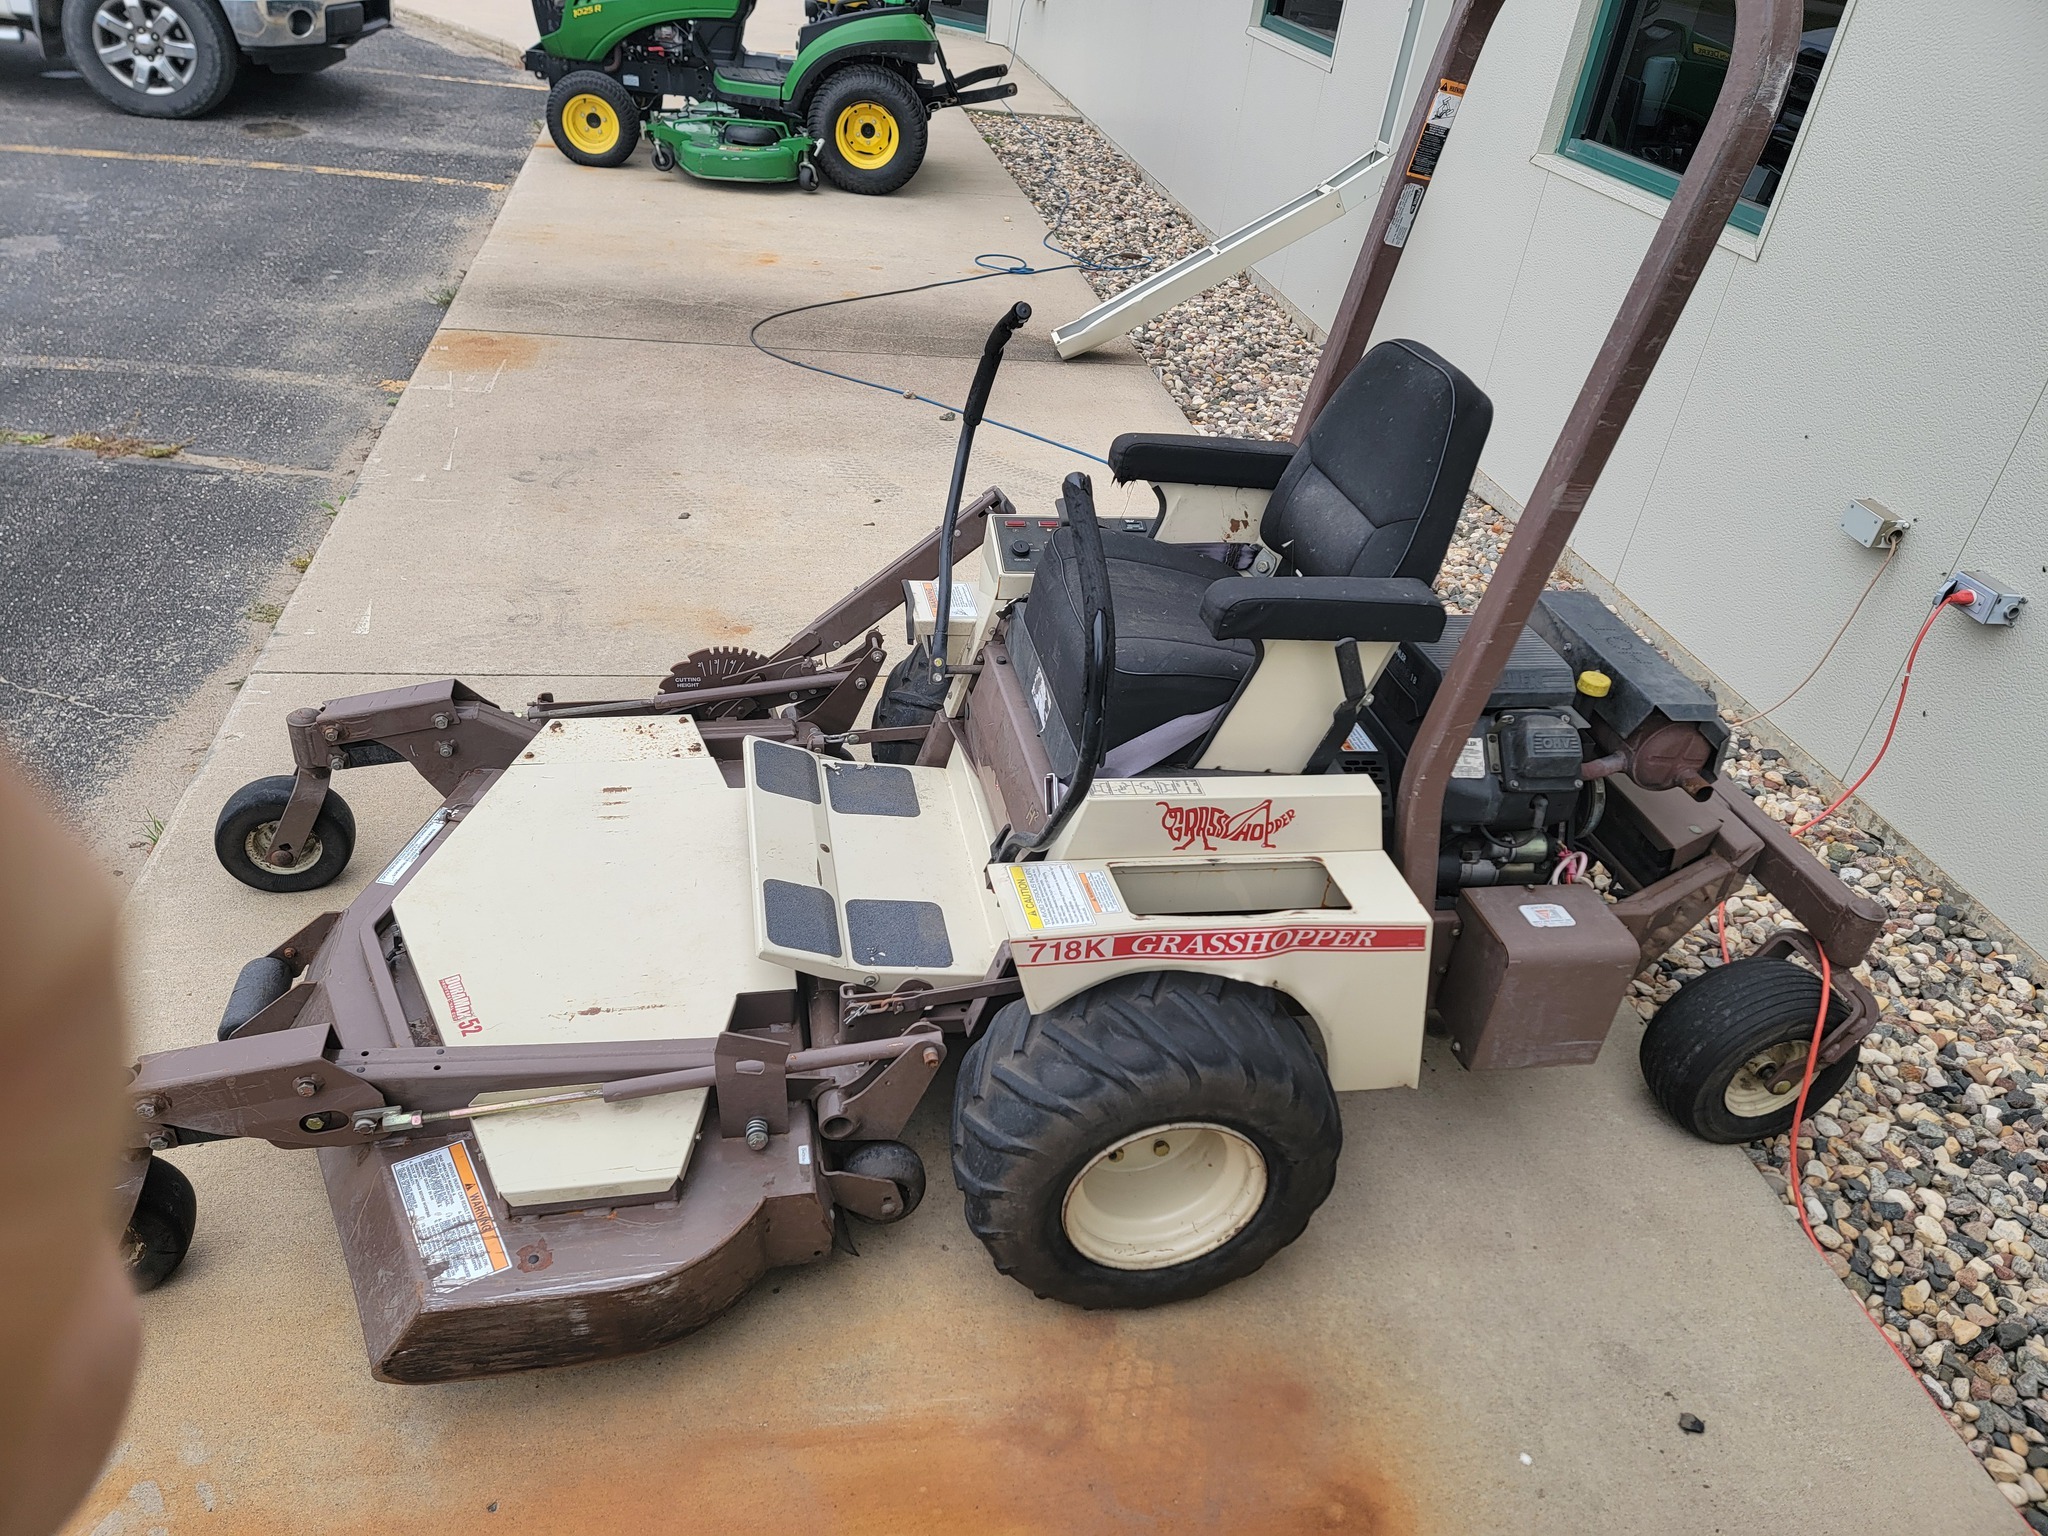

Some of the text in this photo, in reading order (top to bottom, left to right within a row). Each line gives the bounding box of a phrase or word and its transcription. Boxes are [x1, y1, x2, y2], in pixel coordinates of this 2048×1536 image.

[1544, 739, 1570, 749] OHV
[1156, 800, 1297, 850] GRASSHOPPER
[1015, 877, 1035, 908] CAUTION
[1029, 930, 1378, 963] 718K GRASSHOPPER
[443, 975, 483, 1037] DURAMAX 52
[457, 1190, 465, 1200] CAN
[467, 1191, 492, 1232] WARNING
